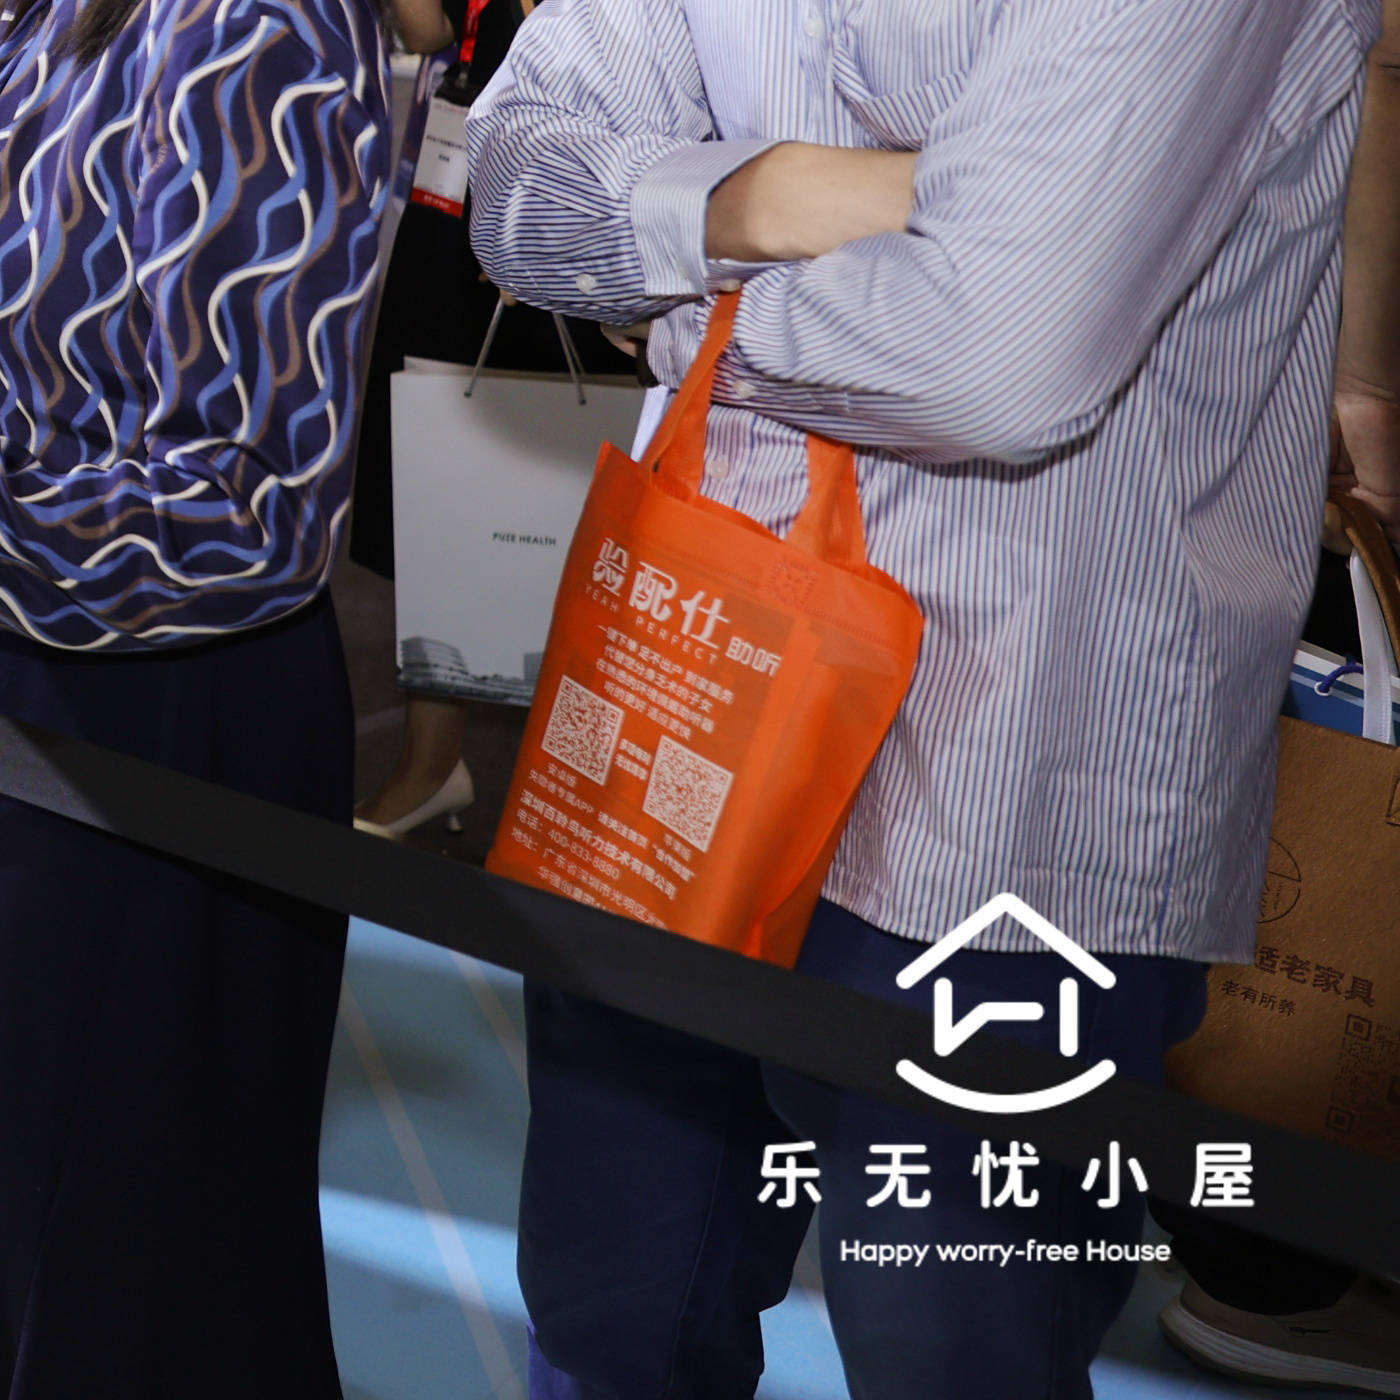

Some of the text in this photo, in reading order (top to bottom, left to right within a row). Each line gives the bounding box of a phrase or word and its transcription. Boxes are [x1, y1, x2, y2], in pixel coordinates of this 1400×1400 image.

[519, 535, 557, 547] HEALTH
[585, 584, 718, 664] YEAH PERFECT
[725, 636, 782, 677] 助听
[1220, 979, 1297, 1017] 老有所养
